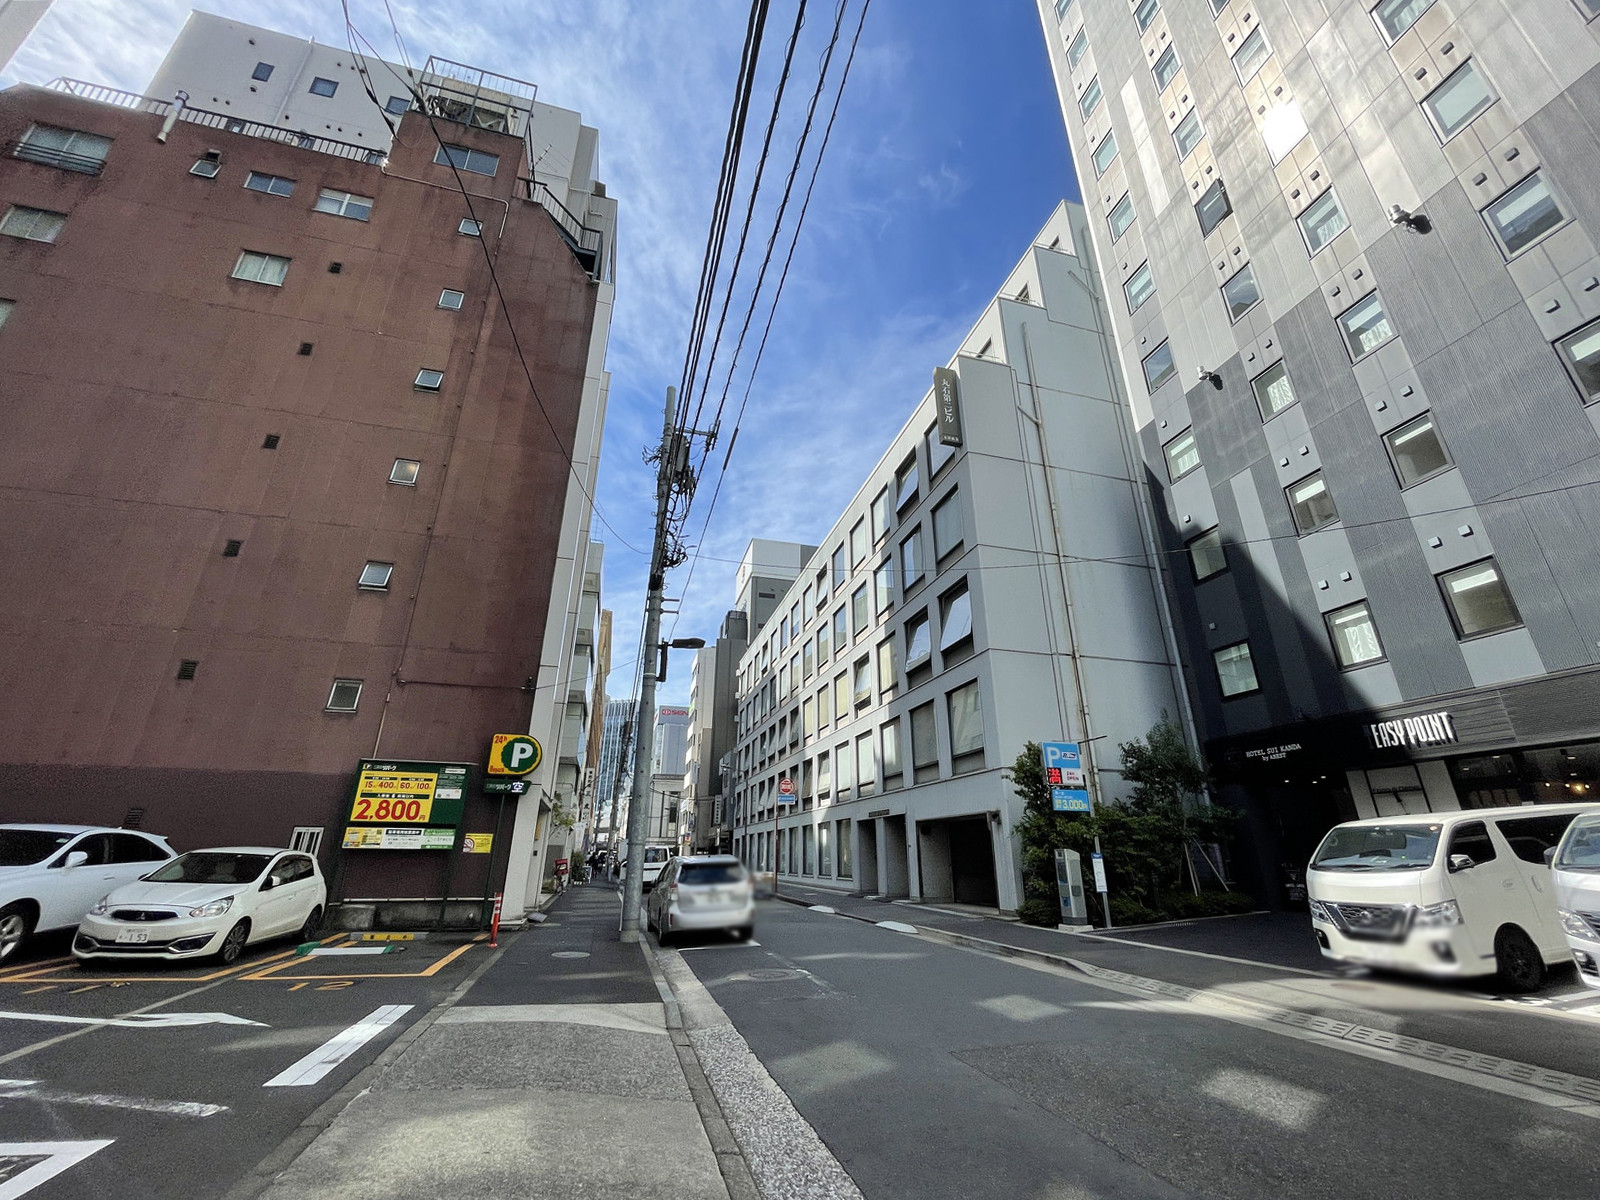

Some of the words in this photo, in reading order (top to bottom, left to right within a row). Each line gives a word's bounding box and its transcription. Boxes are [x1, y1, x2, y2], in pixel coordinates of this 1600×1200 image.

[1370, 720, 1405, 748] EASY
[1403, 711, 1454, 744] POINT
[510, 742, 534, 768] P
[1046, 746, 1061, 768] P
[1245, 749, 1266, 758] HOTEL
[511, 781, 525, 793] 空
